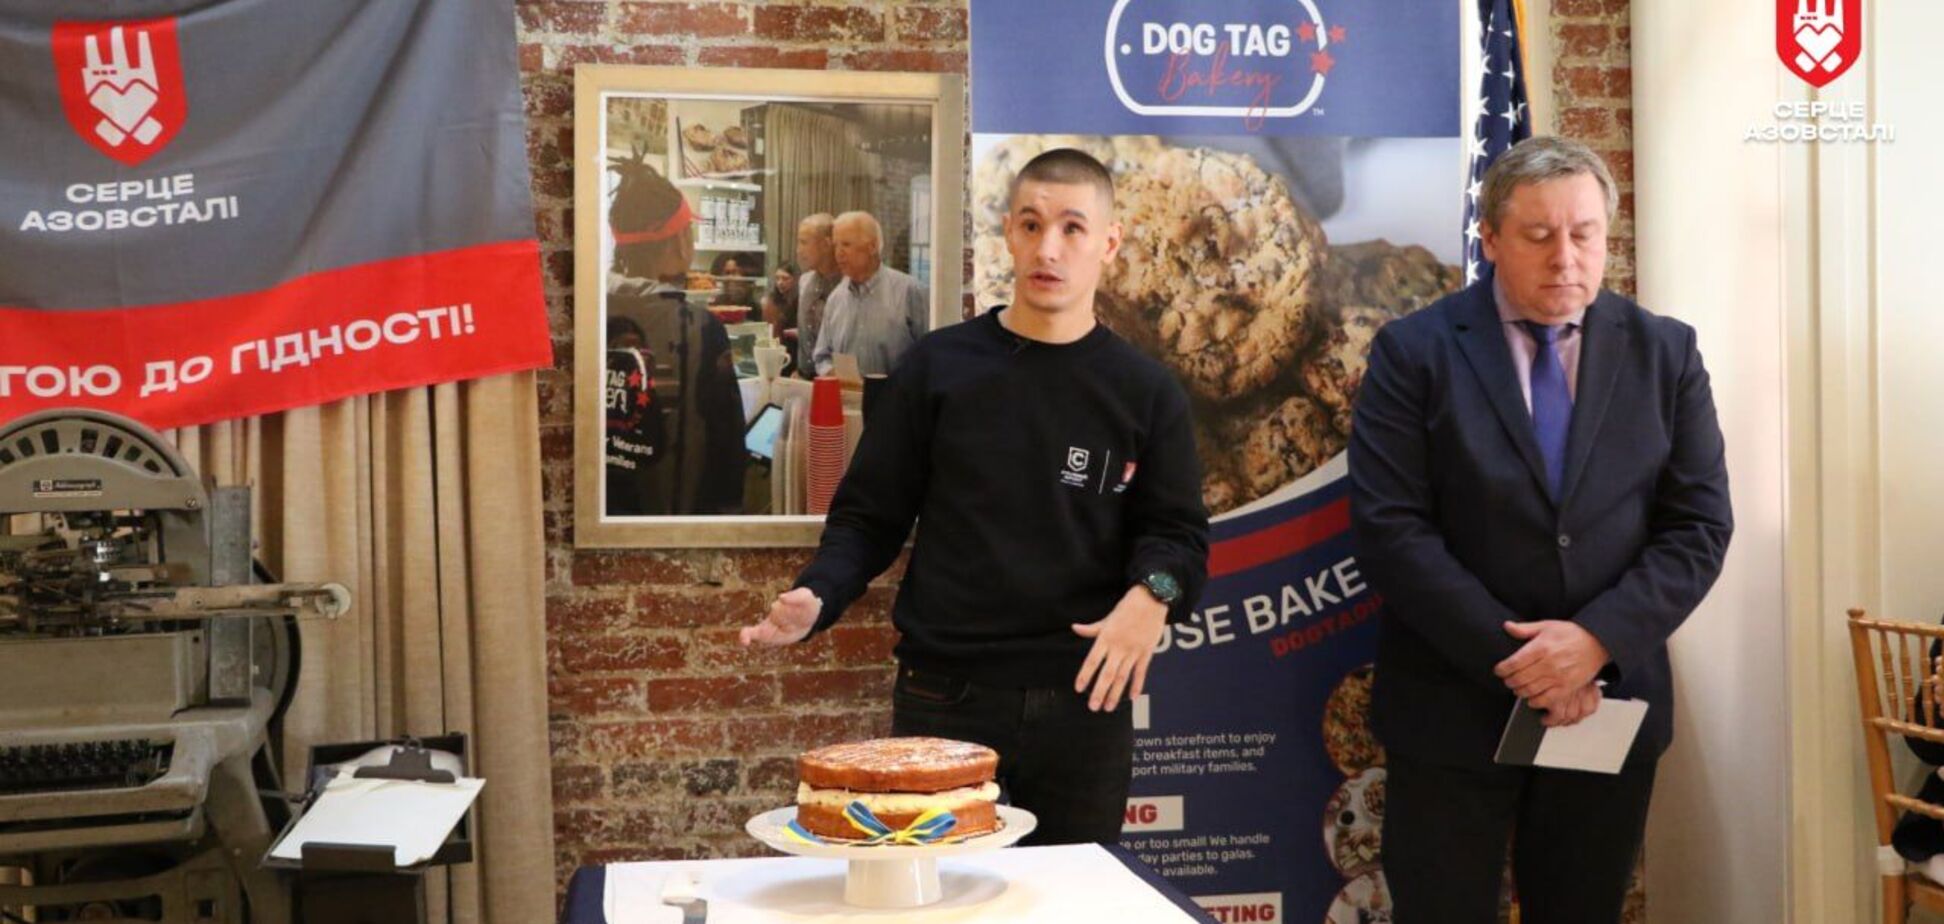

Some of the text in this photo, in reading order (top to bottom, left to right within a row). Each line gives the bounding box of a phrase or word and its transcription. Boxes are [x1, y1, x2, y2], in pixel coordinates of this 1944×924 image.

[1142, 22, 1291, 57] DOG TAG
[1158, 40, 1282, 131] Bakery
[66, 173, 194, 203] СЕРЦЕ
[20, 195, 239, 232] АЗОВСТАЛІ
[230, 303, 476, 375] ГІДНОСТІ!
[1243, 556, 1368, 635] BAKE
[1165, 733, 1226, 747] storefront
[1228, 733, 1241, 745] to
[1243, 731, 1276, 746] enjoy
[1143, 748, 1200, 762] breakfast
[1203, 747, 1239, 760] items,
[1241, 746, 1264, 758] and
[1160, 762, 1204, 776] military
[1207, 760, 1257, 774] families.
[1134, 839, 1147, 850] or
[1150, 837, 1170, 849] too
[1209, 835, 1227, 847] We
[1229, 832, 1271, 845] handle
[1161, 850, 1202, 865] parties
[1206, 849, 1218, 860] to
[1220, 848, 1256, 864] galas.
[1162, 863, 1218, 877] available.
